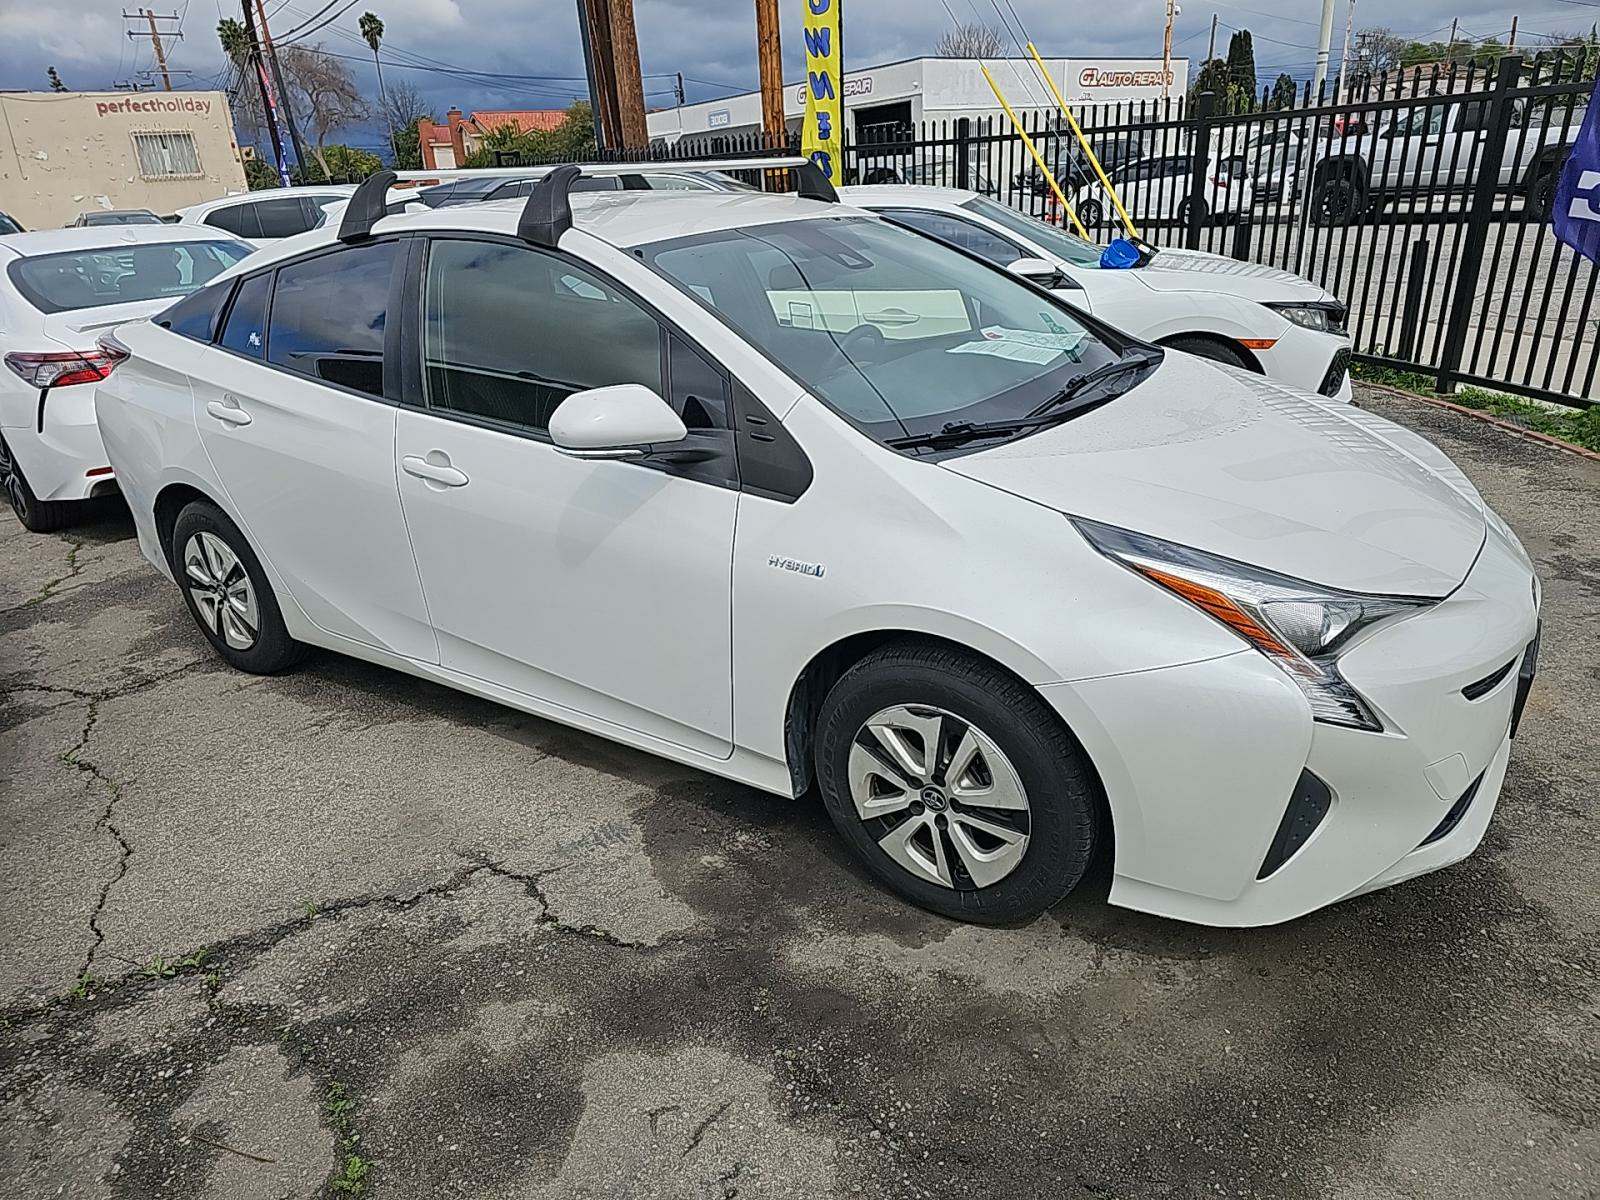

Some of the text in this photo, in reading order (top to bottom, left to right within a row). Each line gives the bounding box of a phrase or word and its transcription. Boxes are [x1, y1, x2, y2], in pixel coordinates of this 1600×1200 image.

[1079, 68, 1098, 87] G1
[1099, 71, 1132, 86] AUTO
[769, 556, 825, 577] HYBRID
